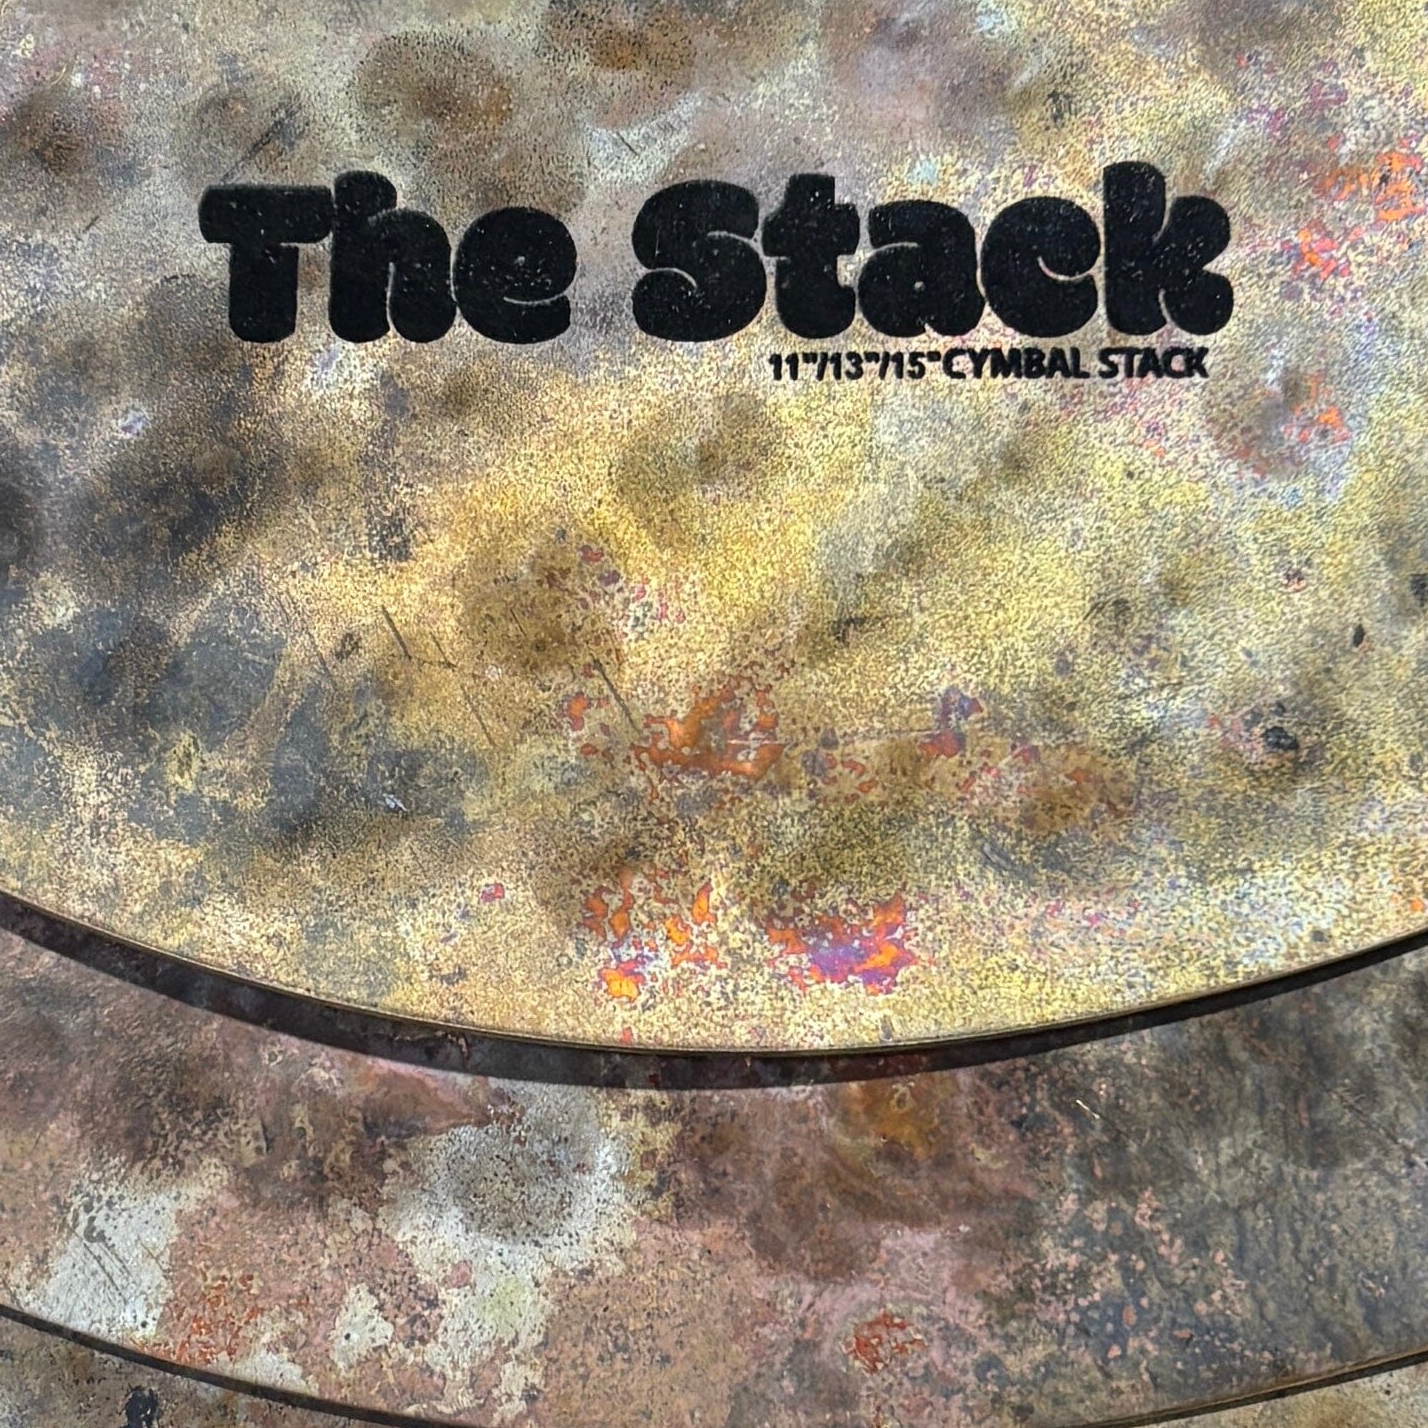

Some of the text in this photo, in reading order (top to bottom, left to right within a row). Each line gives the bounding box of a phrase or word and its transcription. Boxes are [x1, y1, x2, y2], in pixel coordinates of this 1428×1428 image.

[198, 161, 1234, 344] The Stack
[1097, 346, 1210, 379] STACK
